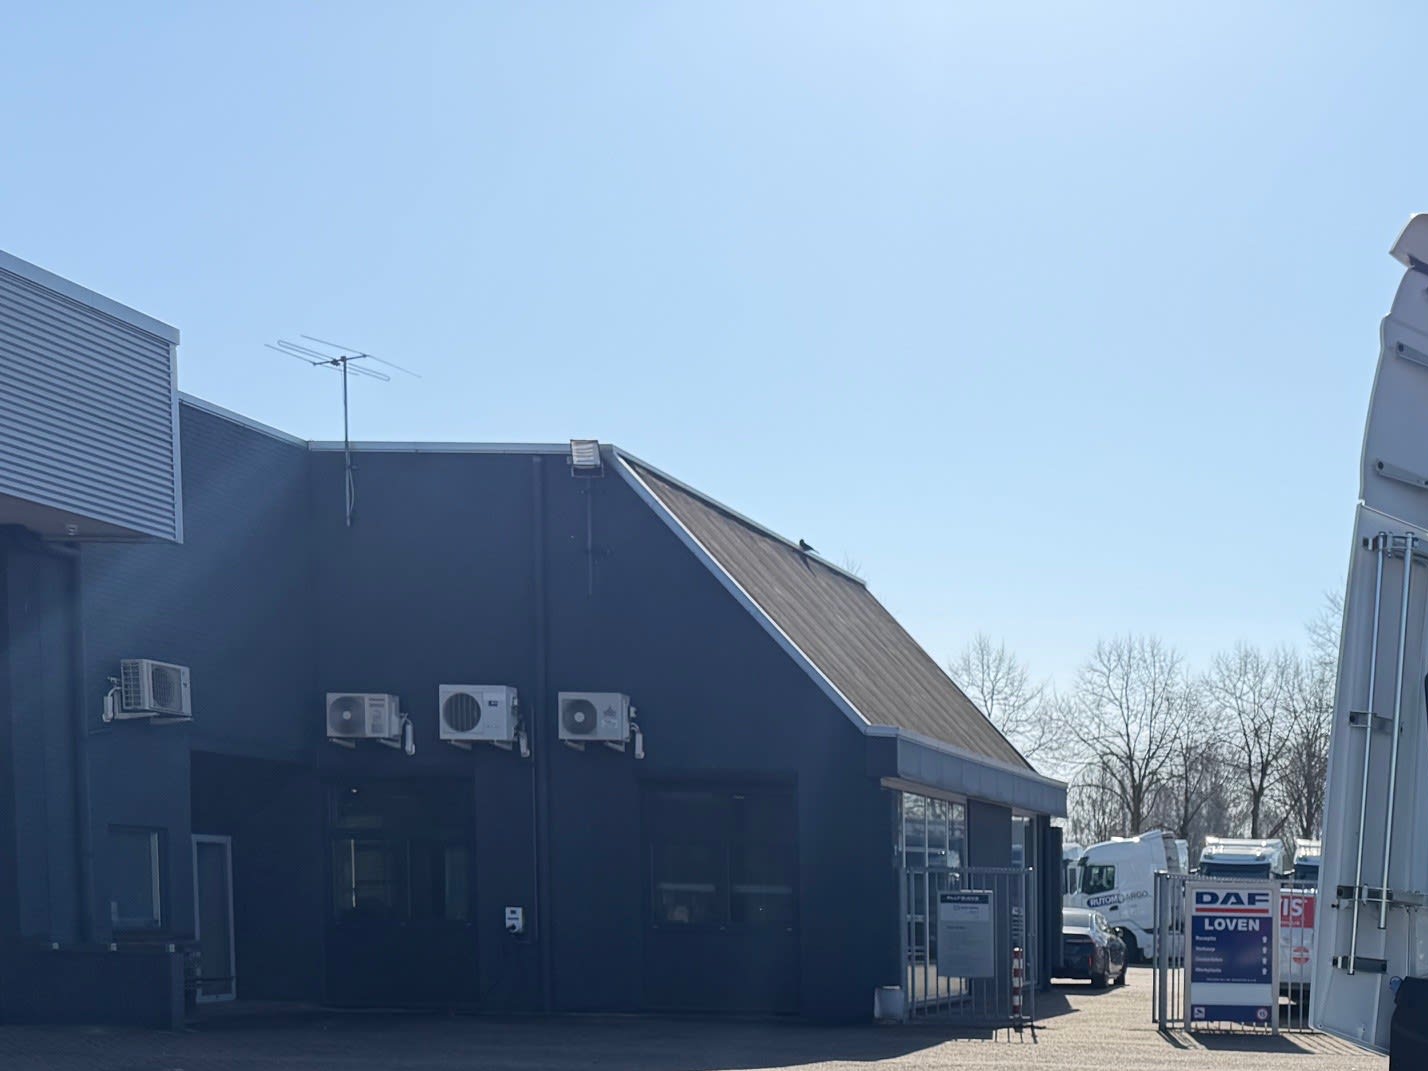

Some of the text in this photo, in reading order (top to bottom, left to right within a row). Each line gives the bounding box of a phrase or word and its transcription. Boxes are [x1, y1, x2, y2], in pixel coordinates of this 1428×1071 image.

[1195, 891, 1269, 905] DAF
[1280, 898, 1304, 917] IS
[1204, 918, 1260, 931] LOVEN
